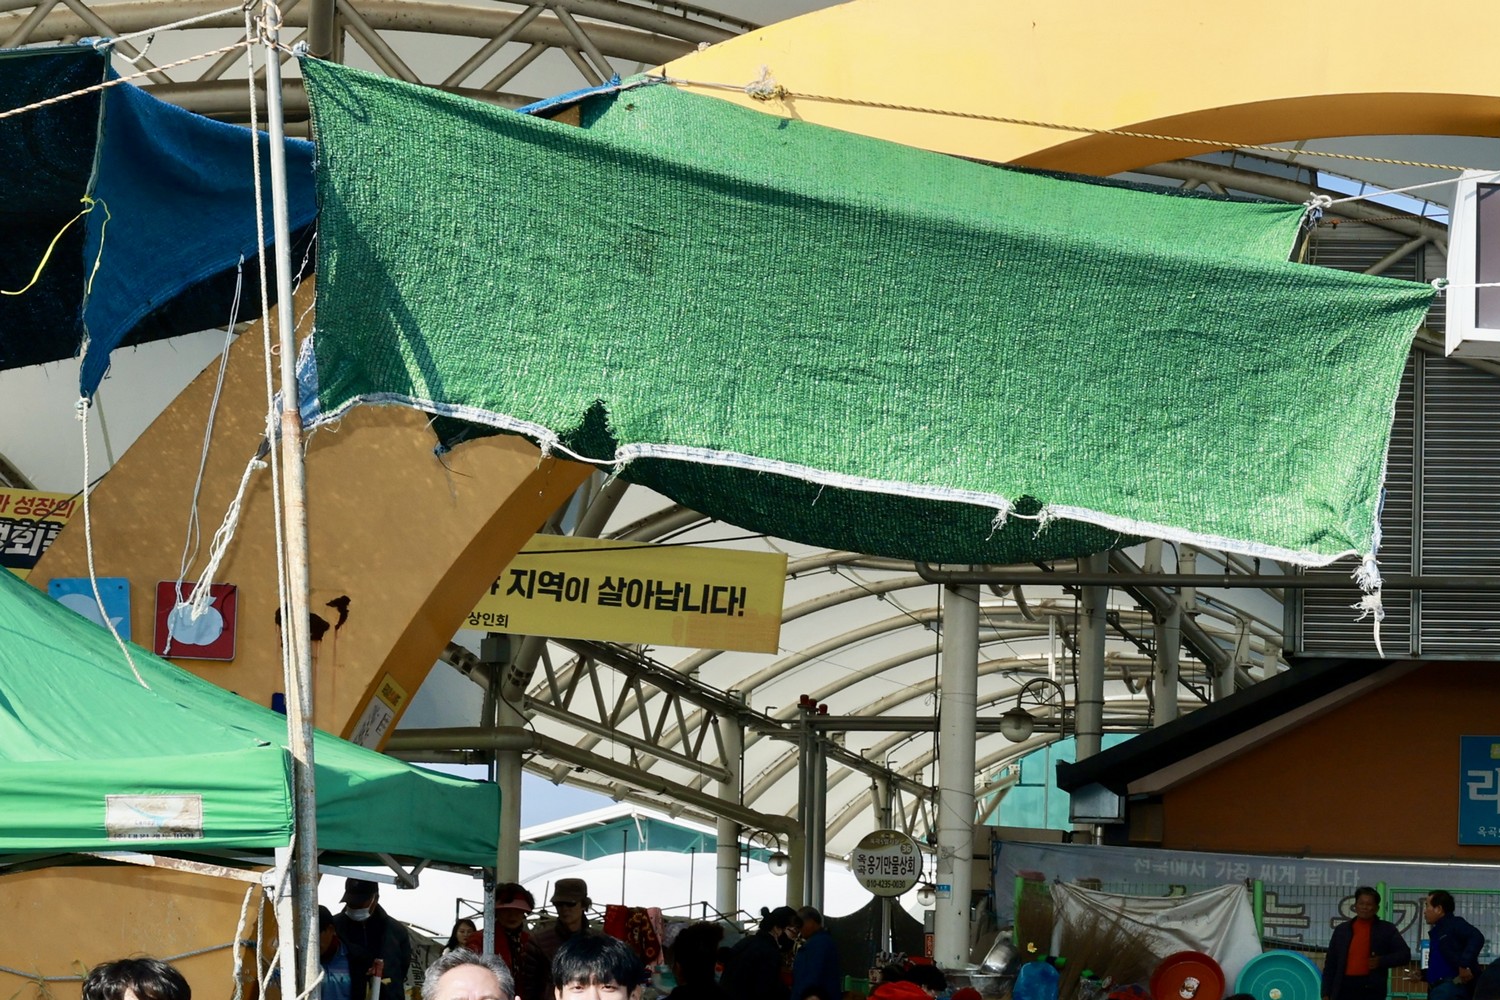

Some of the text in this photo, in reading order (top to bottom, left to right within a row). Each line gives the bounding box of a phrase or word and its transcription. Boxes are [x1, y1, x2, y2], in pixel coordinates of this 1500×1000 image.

[13, 496, 76, 519] 성장의
[506, 569, 588, 604] 지역이
[597, 575, 747, 617] 살아납니다!
[467, 611, 509, 629] 상인회
[901, 844, 912, 853] 36
[867, 855, 915, 876] 옹기만물상회
[1258, 865, 1296, 885] 싸게
